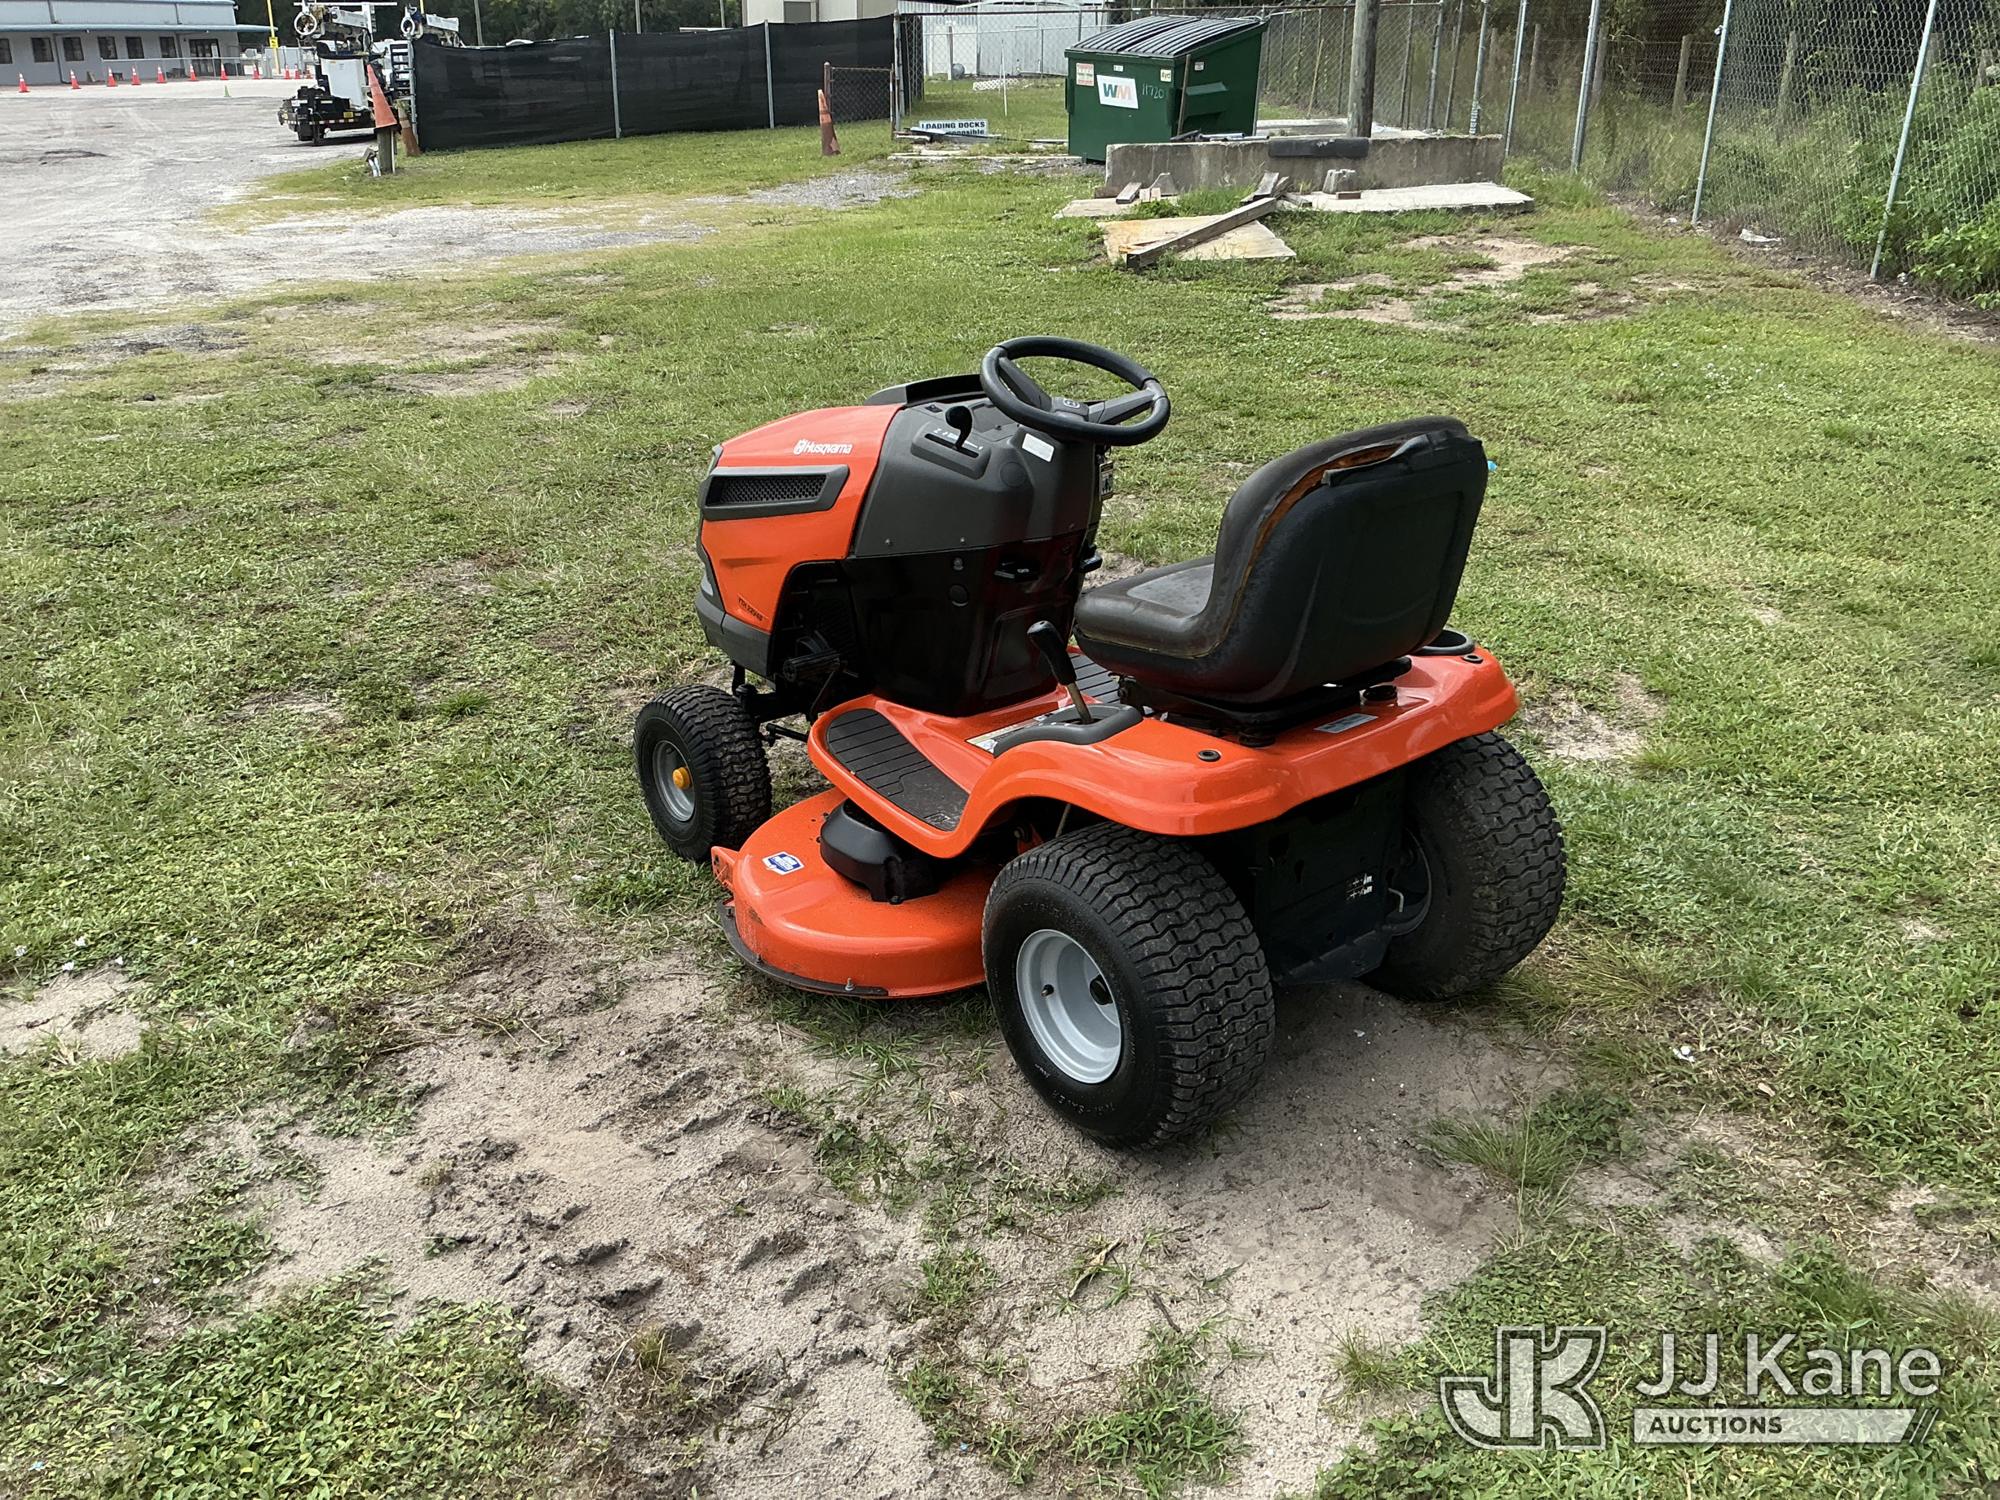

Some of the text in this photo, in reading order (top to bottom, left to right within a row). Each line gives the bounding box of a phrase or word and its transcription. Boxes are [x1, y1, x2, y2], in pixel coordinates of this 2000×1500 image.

[1102, 82, 1133, 101] WM
[921, 122, 956, 130] LOADING
[803, 440, 853, 455] Husqvarna
